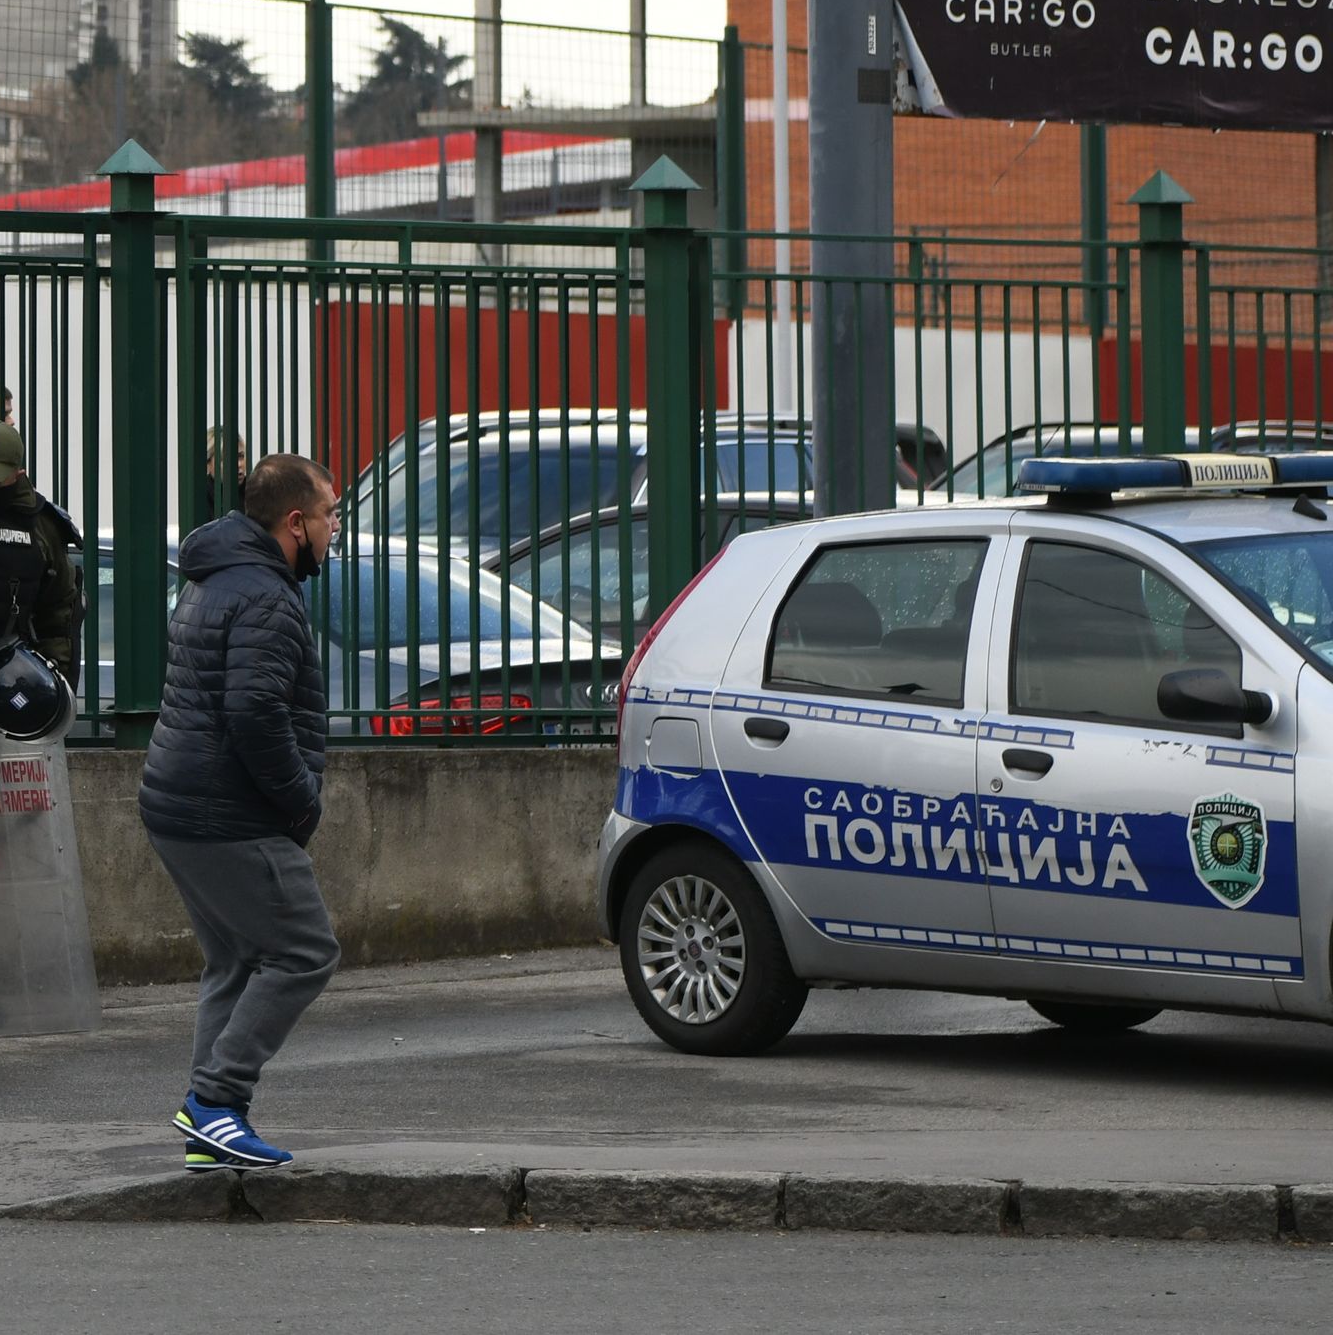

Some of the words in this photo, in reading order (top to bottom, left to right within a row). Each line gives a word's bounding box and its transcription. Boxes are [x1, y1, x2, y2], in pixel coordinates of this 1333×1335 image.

[990, 42, 1052, 57] BUTLER
[1145, 26, 1323, 73] CAR:GO
[1195, 464, 1269, 482] ПОЛИЦИЈА
[804, 787, 1131, 839] САОБРАЋАЈНА
[1198, 804, 1258, 819] ПОЛИЦИЈА
[805, 813, 1148, 892] ПОЛИЦИЈА
